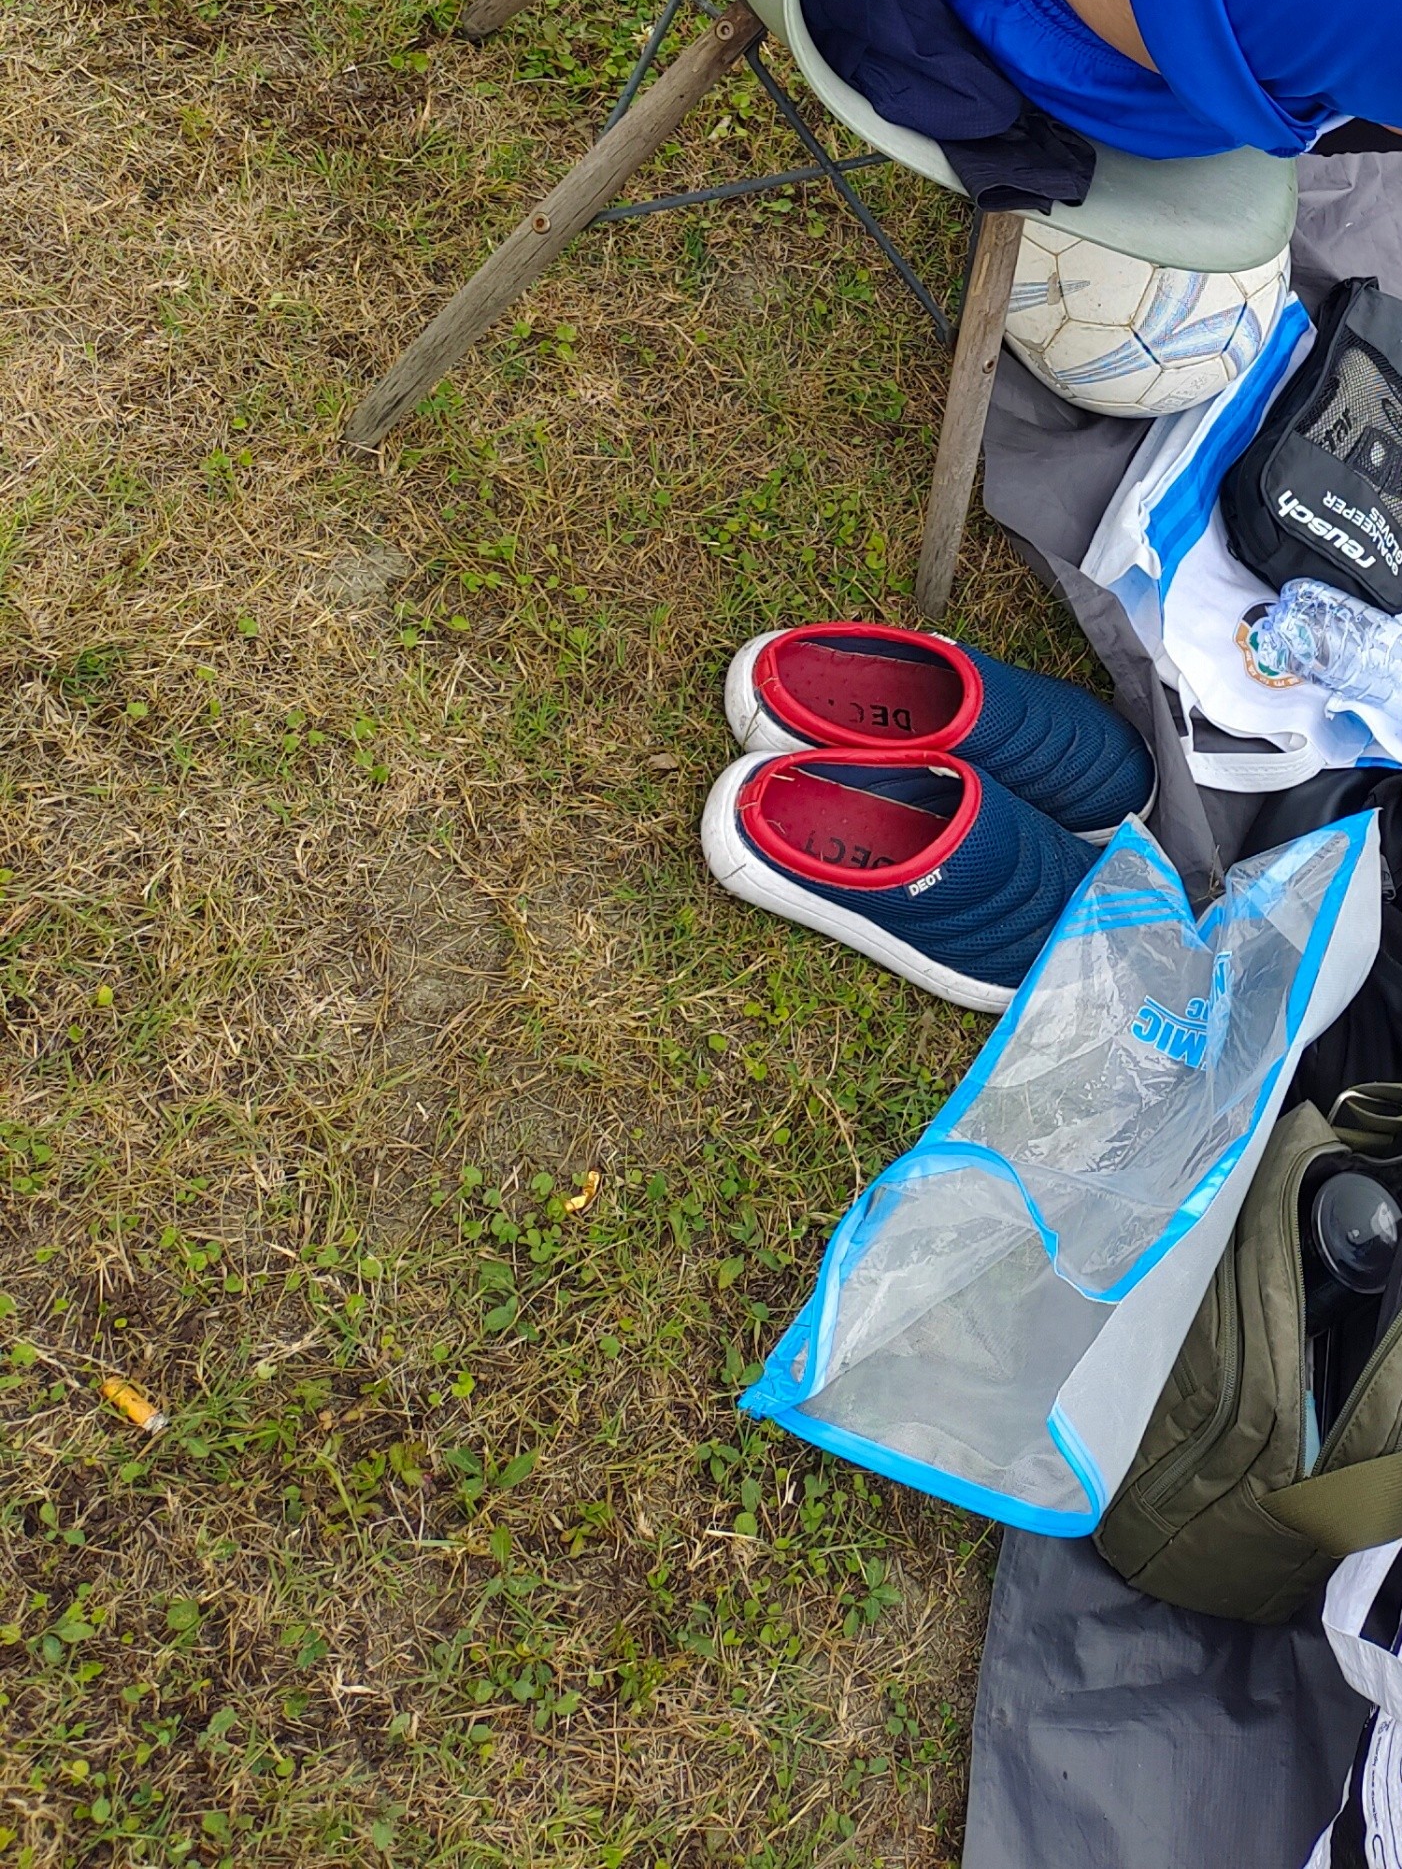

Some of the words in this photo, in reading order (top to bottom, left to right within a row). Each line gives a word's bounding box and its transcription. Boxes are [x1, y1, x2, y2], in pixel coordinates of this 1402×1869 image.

[1277, 489, 1376, 569] reusch
[1323, 490, 1401, 578] GOALKEEPER
[828, 699, 913, 732] DEC
